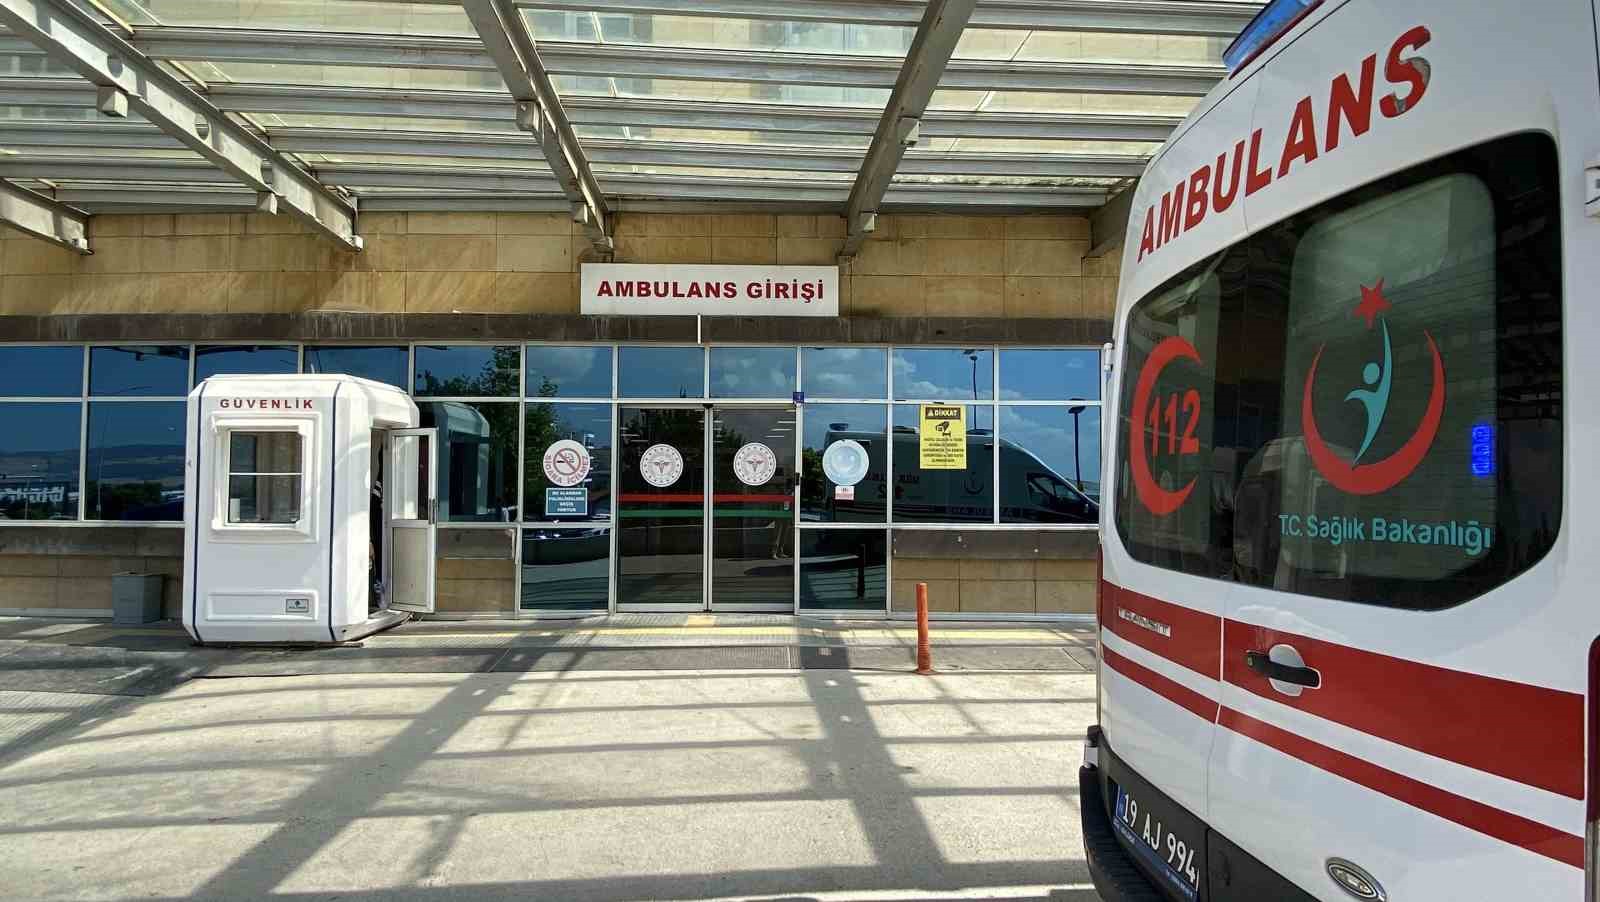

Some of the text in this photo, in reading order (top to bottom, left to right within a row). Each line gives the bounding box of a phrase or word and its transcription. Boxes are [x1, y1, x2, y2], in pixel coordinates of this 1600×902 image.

[1137, 25, 1432, 263] AMBULANS
[597, 278, 824, 304] AMBULANS GİRİŞİ
[219, 396, 313, 409] GÜVENLİK
[1149, 389, 1201, 457] 112
[1278, 514, 1491, 556] T.C. Sağlık Bakanlığı
[1123, 793, 1137, 828] 19
[1142, 813, 1161, 850] AJ
[1167, 832, 1196, 883] 994
